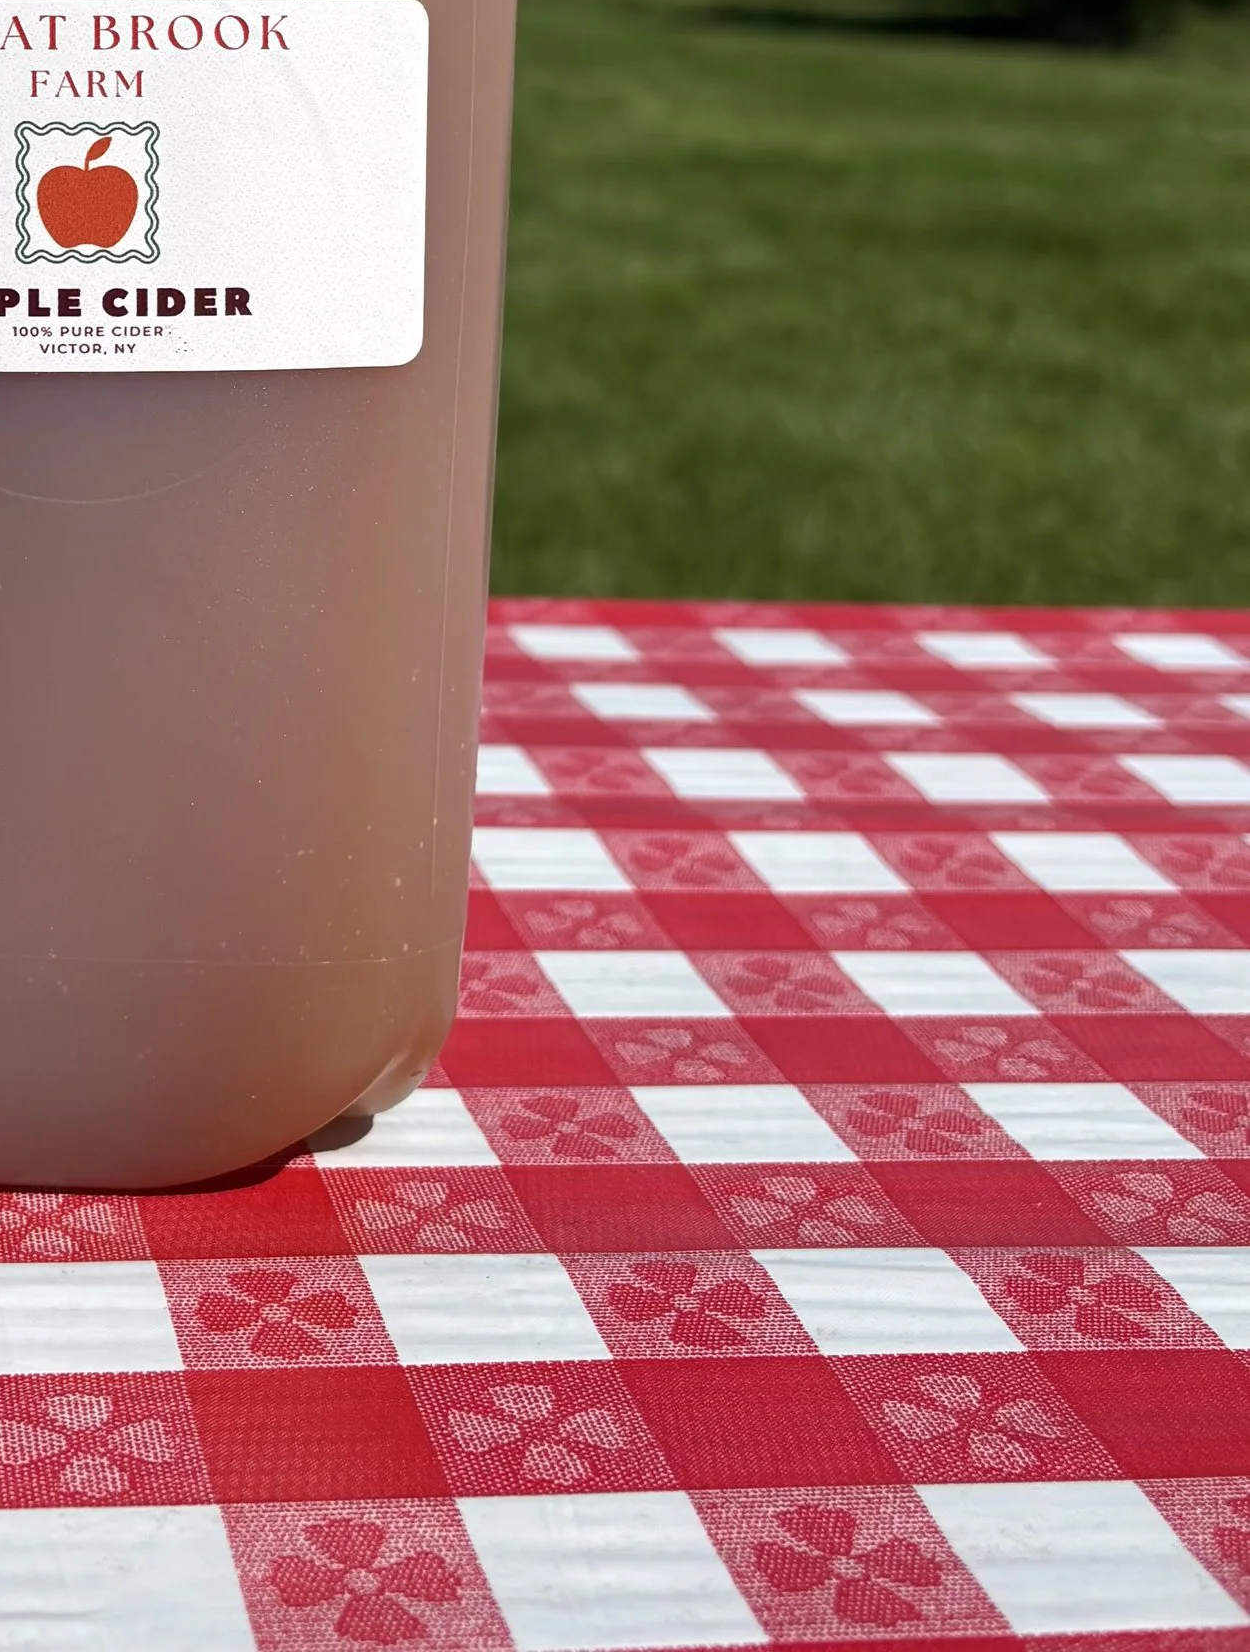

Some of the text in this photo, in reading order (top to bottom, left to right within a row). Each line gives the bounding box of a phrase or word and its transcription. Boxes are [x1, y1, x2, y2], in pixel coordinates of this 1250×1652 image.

[92, 14, 289, 50] BROOK
[30, 70, 144, 98] FARM
[101, 287, 253, 317] CIDER
[12, 326, 164, 337] 100% PURE CIDER
[39, 343, 136, 355] VICTOR, NY
